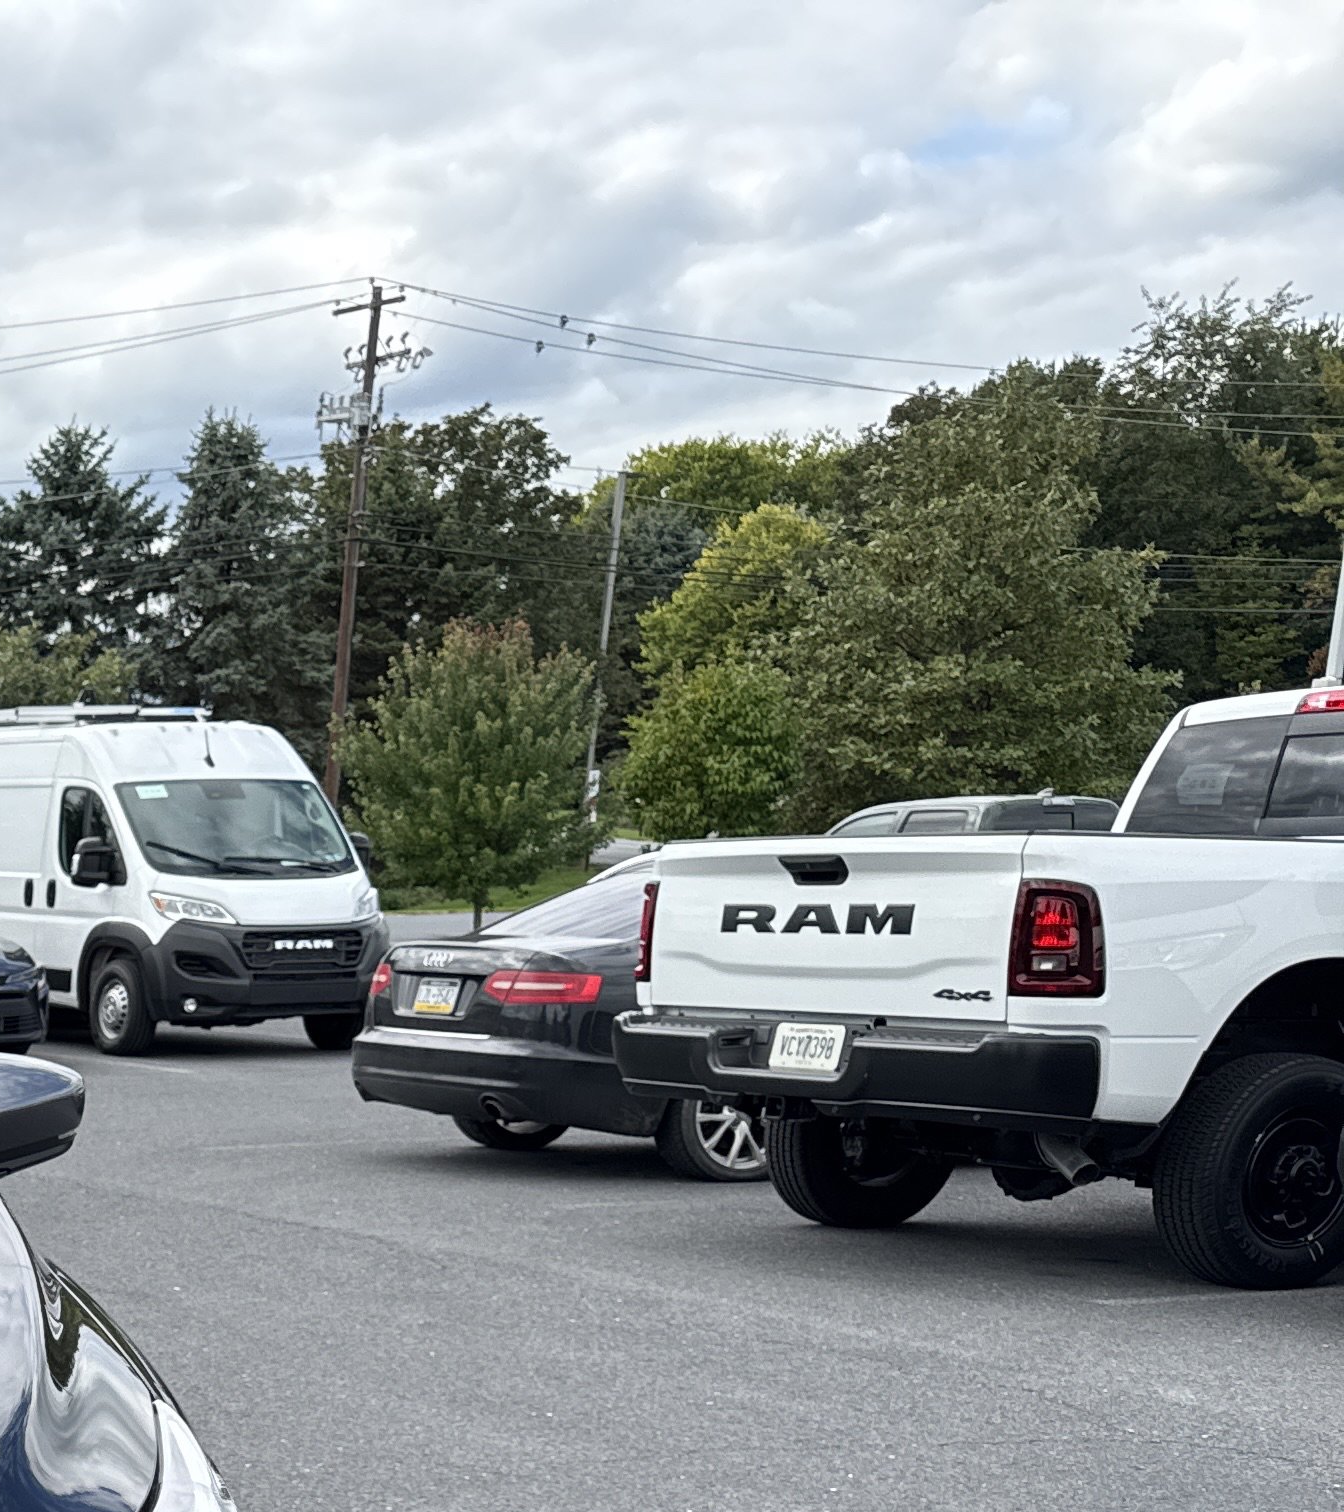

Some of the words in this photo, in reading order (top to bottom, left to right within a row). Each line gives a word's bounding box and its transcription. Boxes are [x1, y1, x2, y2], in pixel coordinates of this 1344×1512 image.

[720, 903, 916, 935] RAM
[274, 939, 333, 950] RAM
[933, 988, 994, 1001] 4x4
